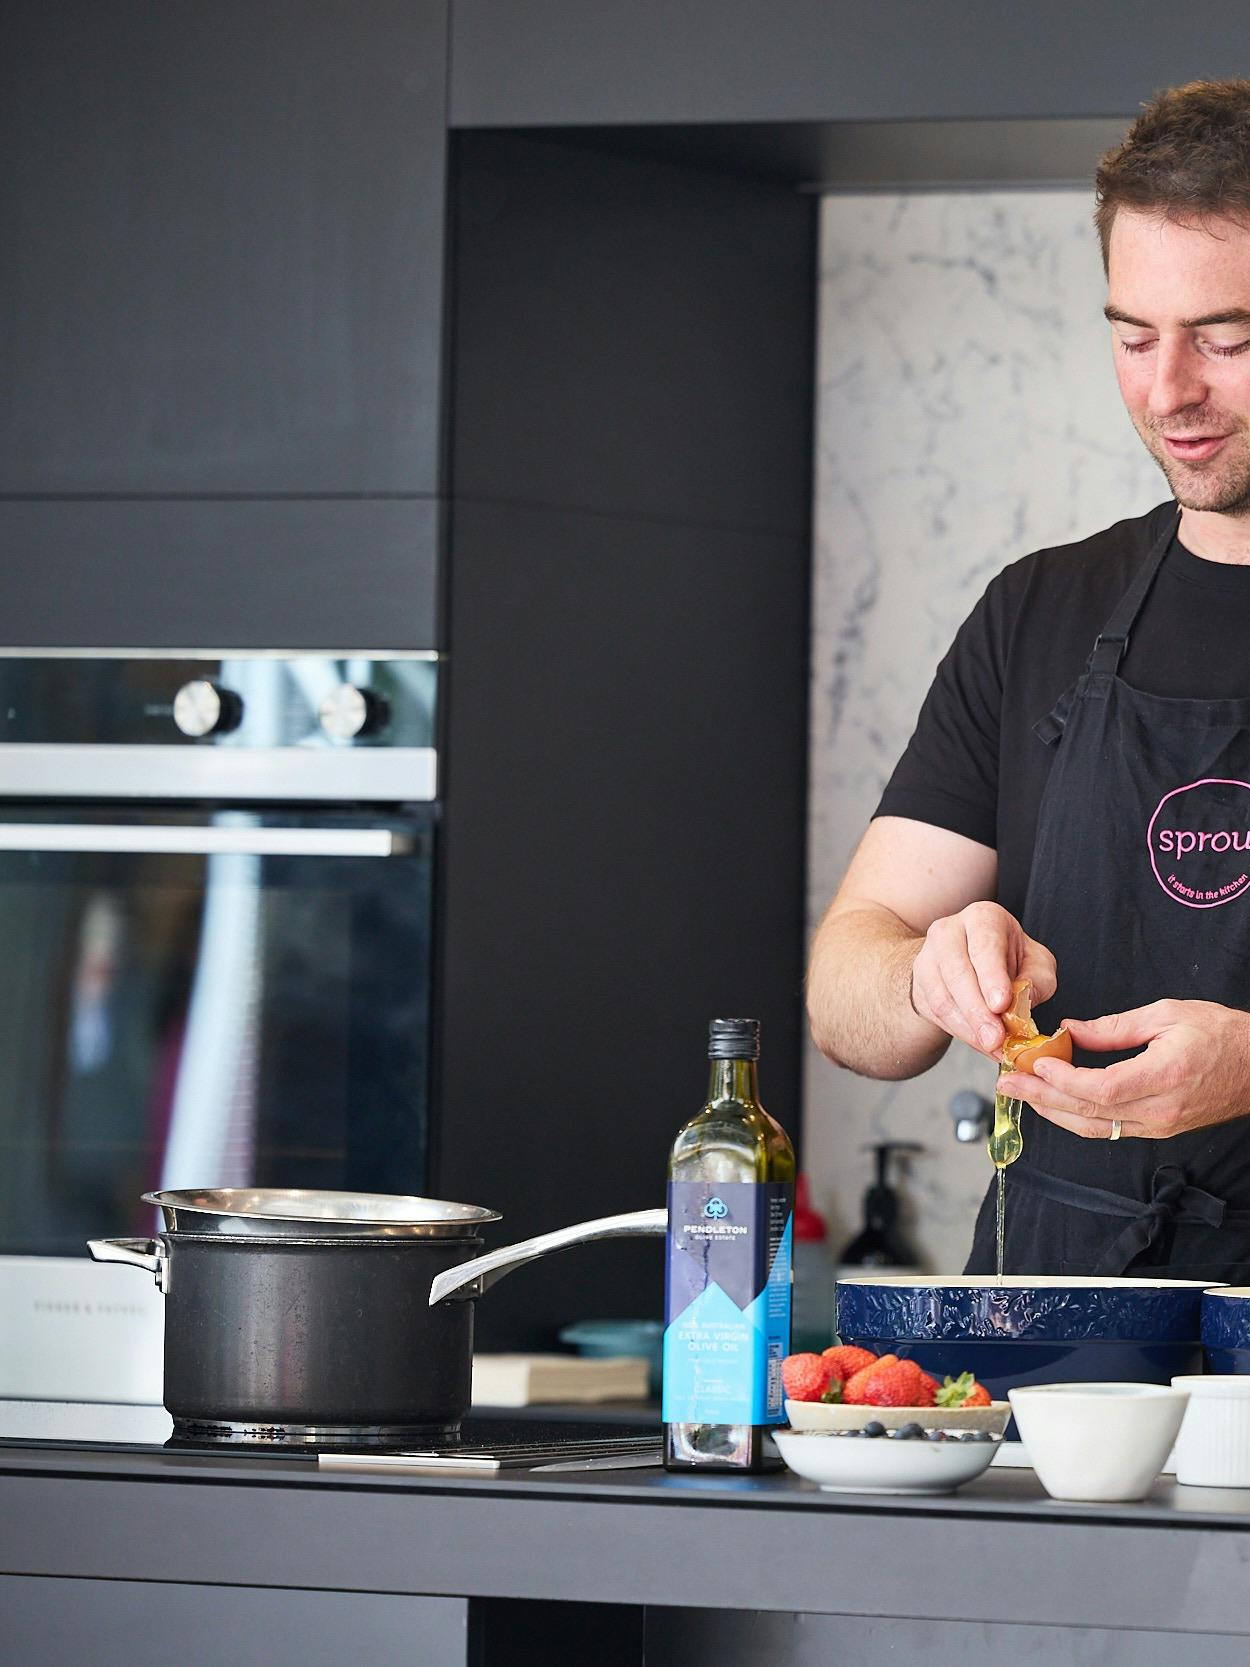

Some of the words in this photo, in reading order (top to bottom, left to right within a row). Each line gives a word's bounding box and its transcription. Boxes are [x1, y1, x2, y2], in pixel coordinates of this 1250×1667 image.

[1167, 874, 1176, 884] it
[1172, 881, 1195, 898] starts
[1195, 890, 1204, 899] in
[1205, 891, 1219, 899] the
[1219, 873, 1249, 896] kitchen
[683, 1225, 748, 1235] PENDLETON
[678, 1331, 710, 1340] EXTRA
[715, 1331, 750, 1341] VIRGIN
[688, 1342, 717, 1351] OLIVE
[722, 1342, 739, 1351] OIL
